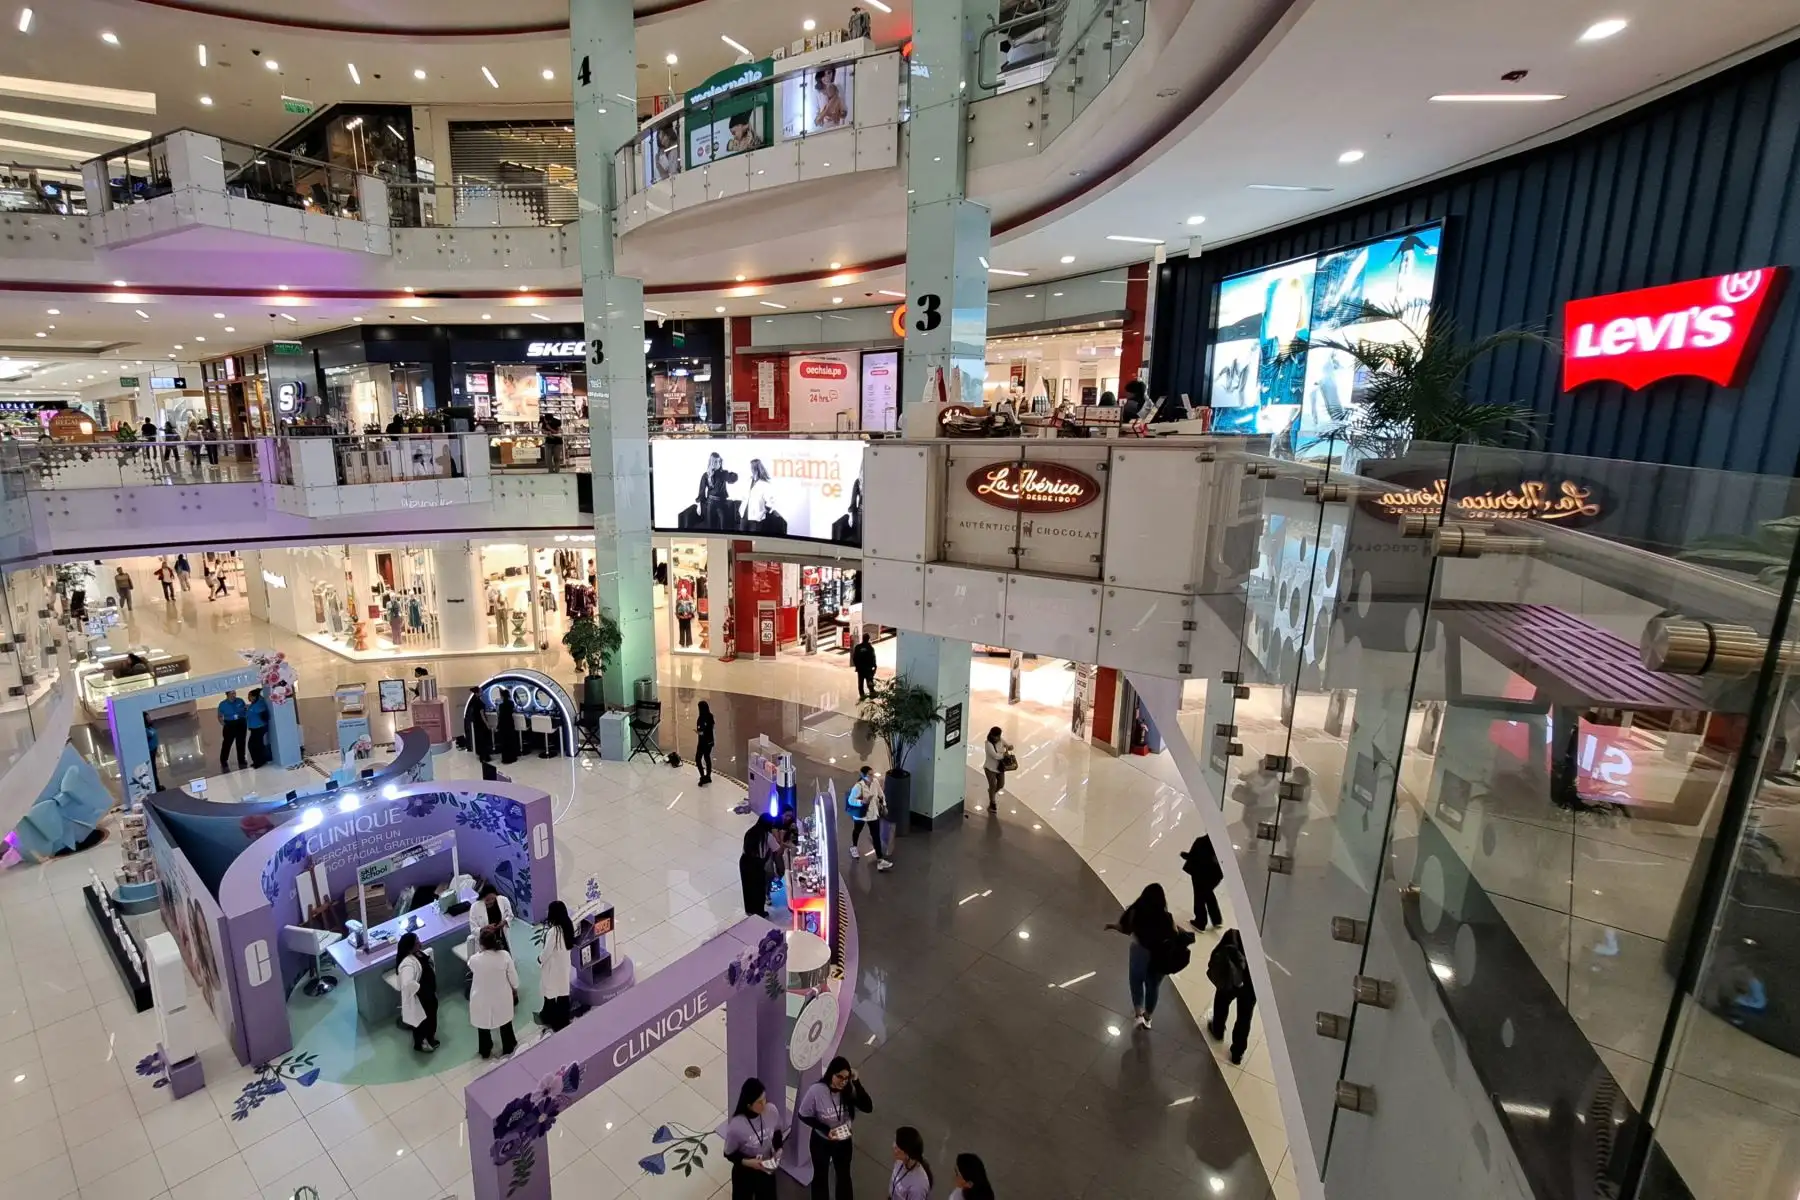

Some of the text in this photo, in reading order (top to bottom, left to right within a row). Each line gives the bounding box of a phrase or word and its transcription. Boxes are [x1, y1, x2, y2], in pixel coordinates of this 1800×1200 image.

[577, 55, 592, 87] 4
[916, 294, 942, 331] 3
[591, 339, 604, 365] 3
[773, 453, 841, 480] mamá
[977, 467, 1084, 499] La Ibérica
[1026, 493, 1052, 502] DESDE
[306, 807, 403, 855] CLINIQUE
[361, 834, 383, 846] POR
[385, 830, 401, 840] UN
[347, 846, 382, 863] FACIAL
[360, 865, 377, 875] skin
[361, 866, 388, 881] school
[613, 990, 709, 1068] CLINIQUE
